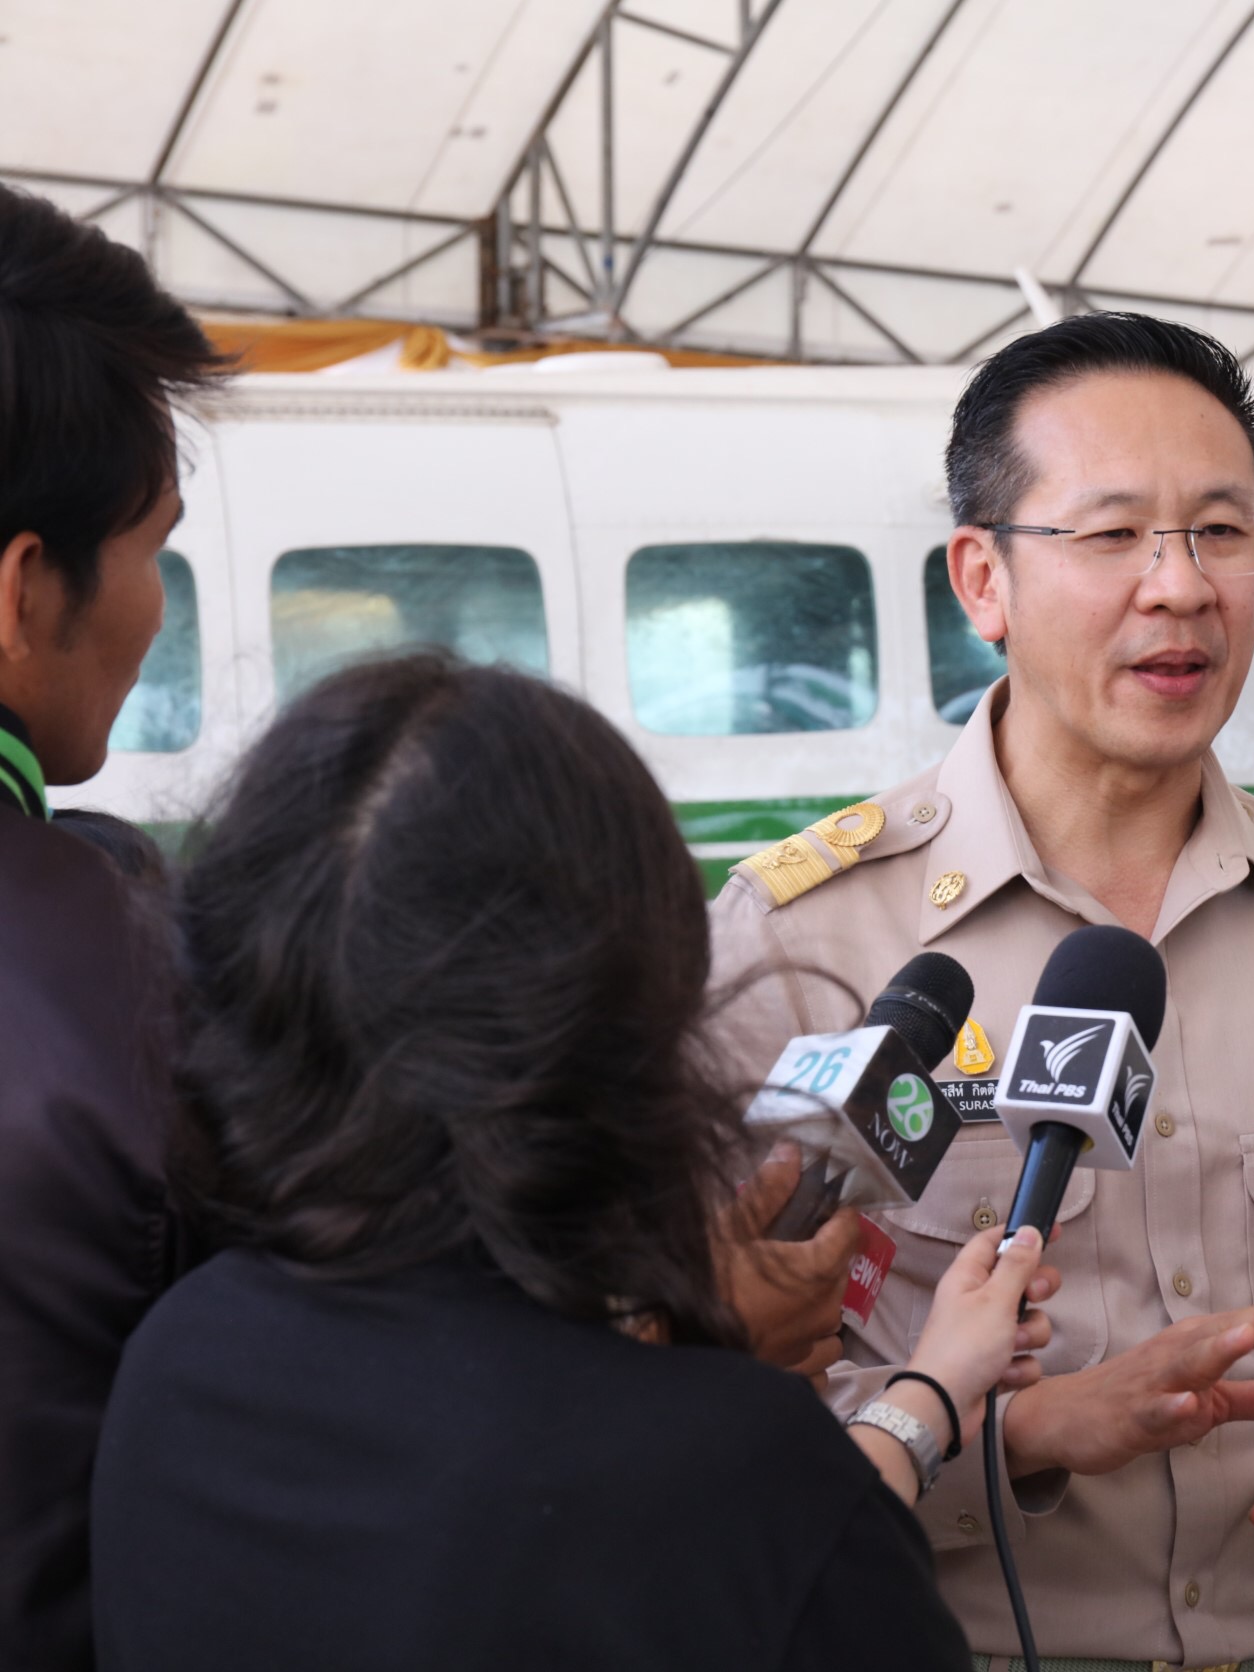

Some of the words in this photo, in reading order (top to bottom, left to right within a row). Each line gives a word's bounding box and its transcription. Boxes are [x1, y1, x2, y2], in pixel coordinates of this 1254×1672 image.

[777, 1046, 852, 1096] 26
[941, 1083, 964, 1098] รสีห์
[972, 1082, 998, 1097] กิตติ
[959, 1100, 996, 1111] SURAS
[1019, 1079, 1055, 1095] Thai
[1053, 1083, 1087, 1098] PBS
[887, 1073, 934, 1141] 26
[868, 1112, 914, 1168] NOW
